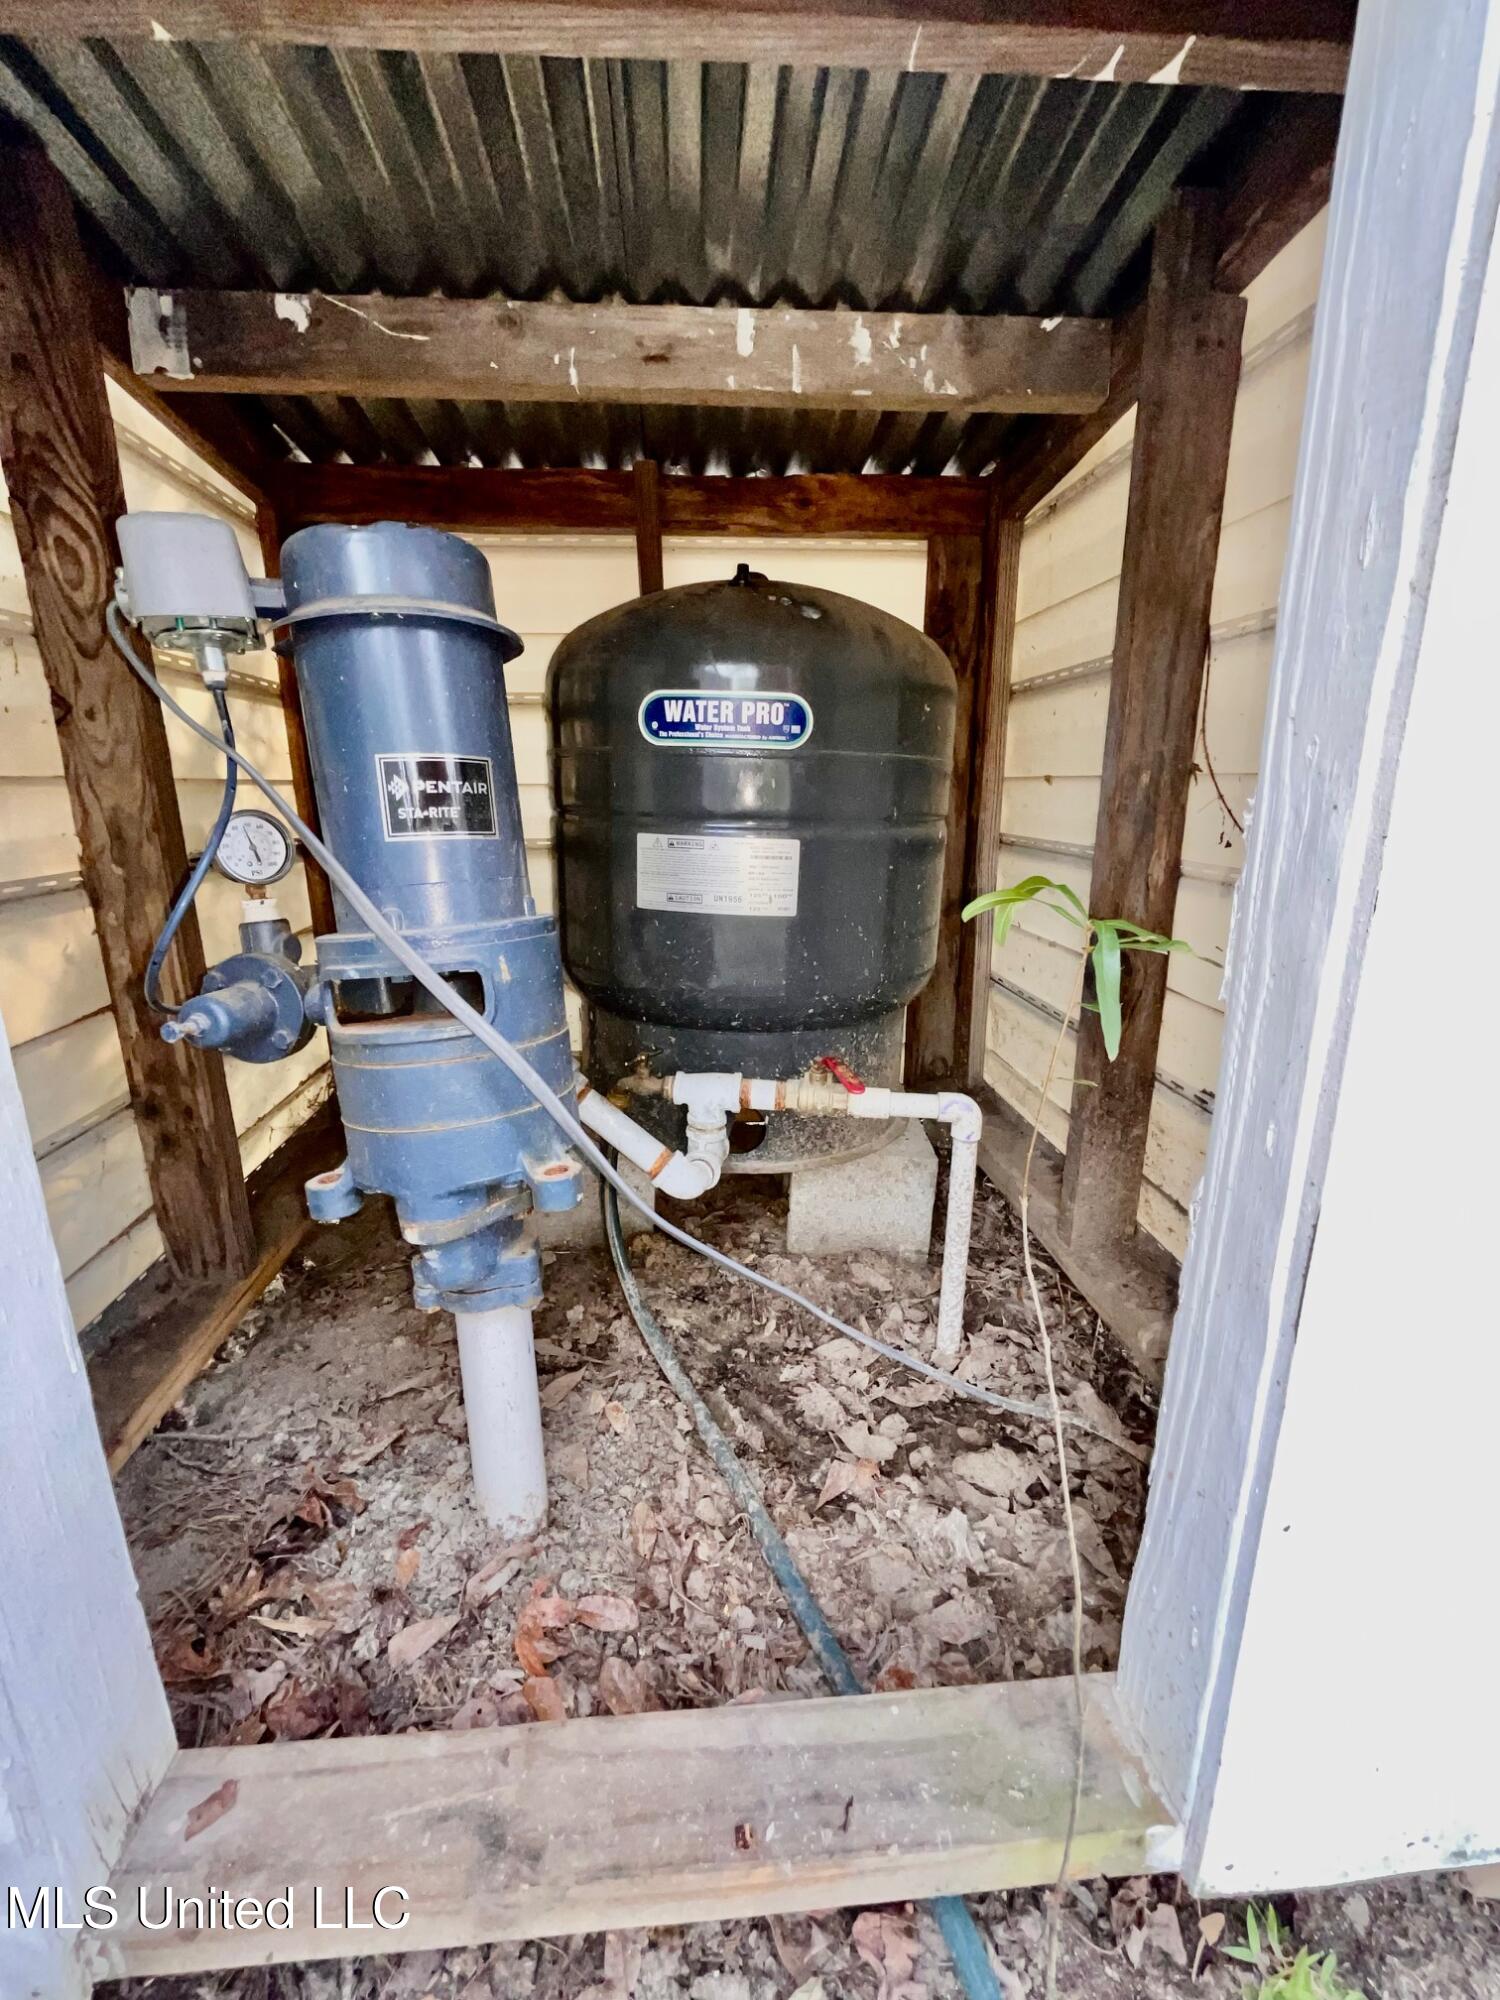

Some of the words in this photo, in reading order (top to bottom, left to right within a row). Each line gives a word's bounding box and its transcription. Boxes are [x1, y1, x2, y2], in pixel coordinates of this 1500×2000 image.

[663, 700, 734, 723] WATER
[741, 701, 785, 725] PRO
[413, 780, 488, 795] PENTAIR
